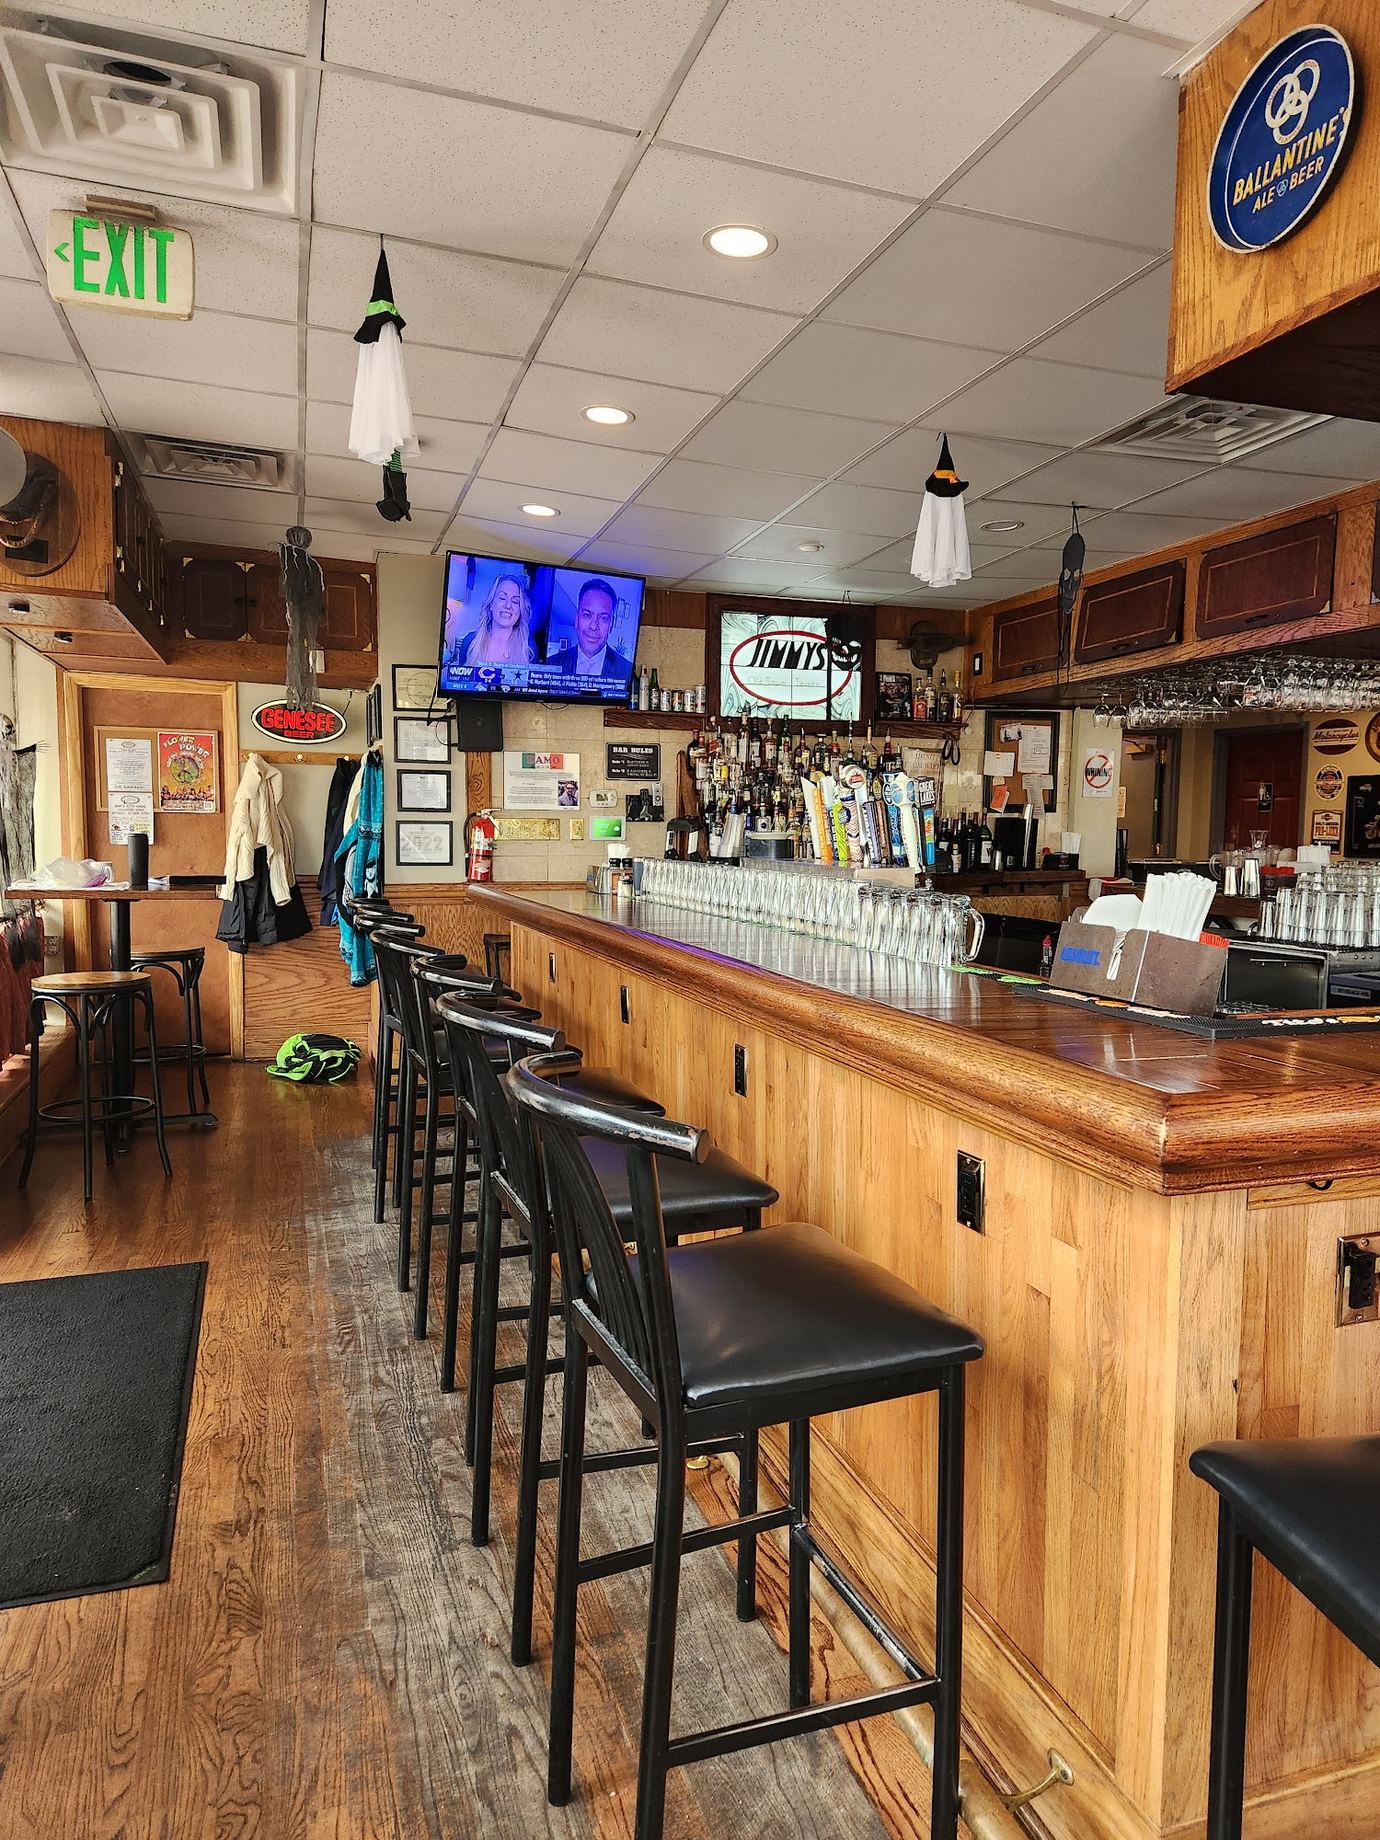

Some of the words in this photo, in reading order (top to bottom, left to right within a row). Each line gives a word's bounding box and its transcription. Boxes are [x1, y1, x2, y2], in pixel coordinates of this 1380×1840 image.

[1252, 186, 1276, 214] ALE
[1288, 155, 1325, 191] BEER
[73, 215, 175, 304] EXIT
[746, 638, 828, 670] JIMMYS
[261, 707, 336, 733] GENESEE
[283, 730, 315, 739] BEER
[1312, 730, 1359, 743] Motorcycles
[179, 743, 210, 759] POWER
